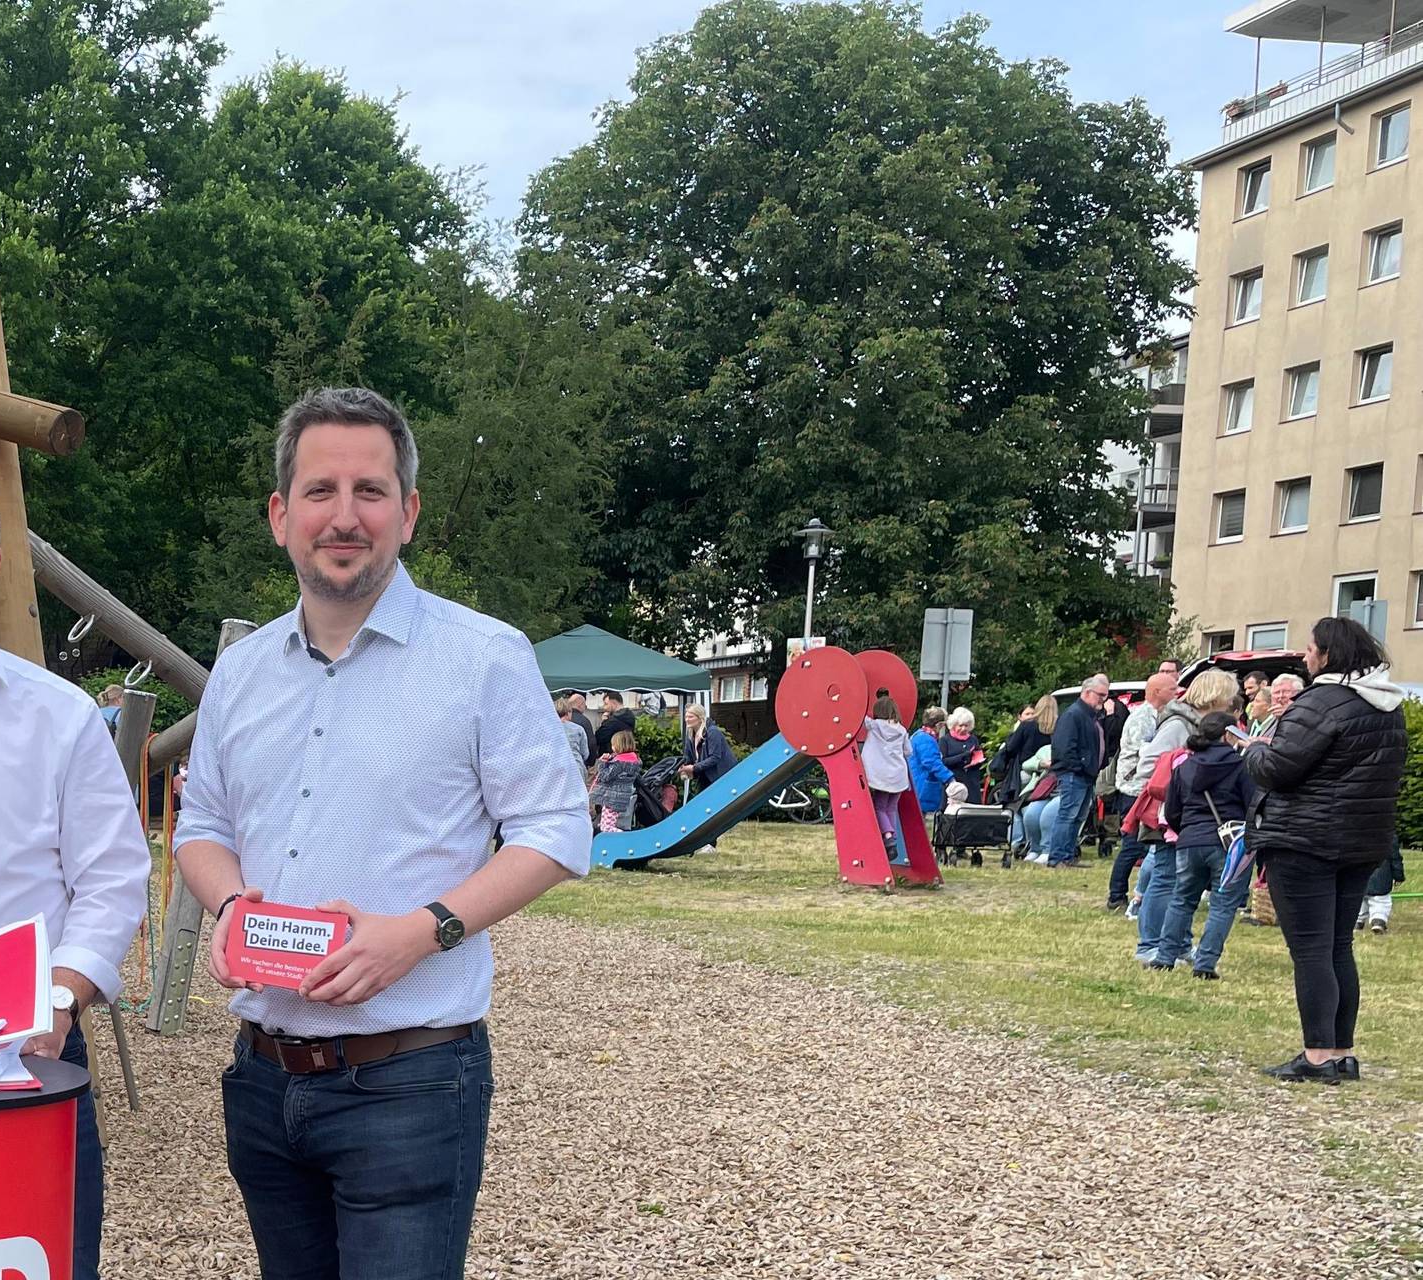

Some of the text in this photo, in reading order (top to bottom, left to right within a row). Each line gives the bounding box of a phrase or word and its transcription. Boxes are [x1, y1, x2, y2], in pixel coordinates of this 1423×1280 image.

[247, 917, 331, 938] Dein Hamm.
[250, 933, 325, 953] Deine Idee.
